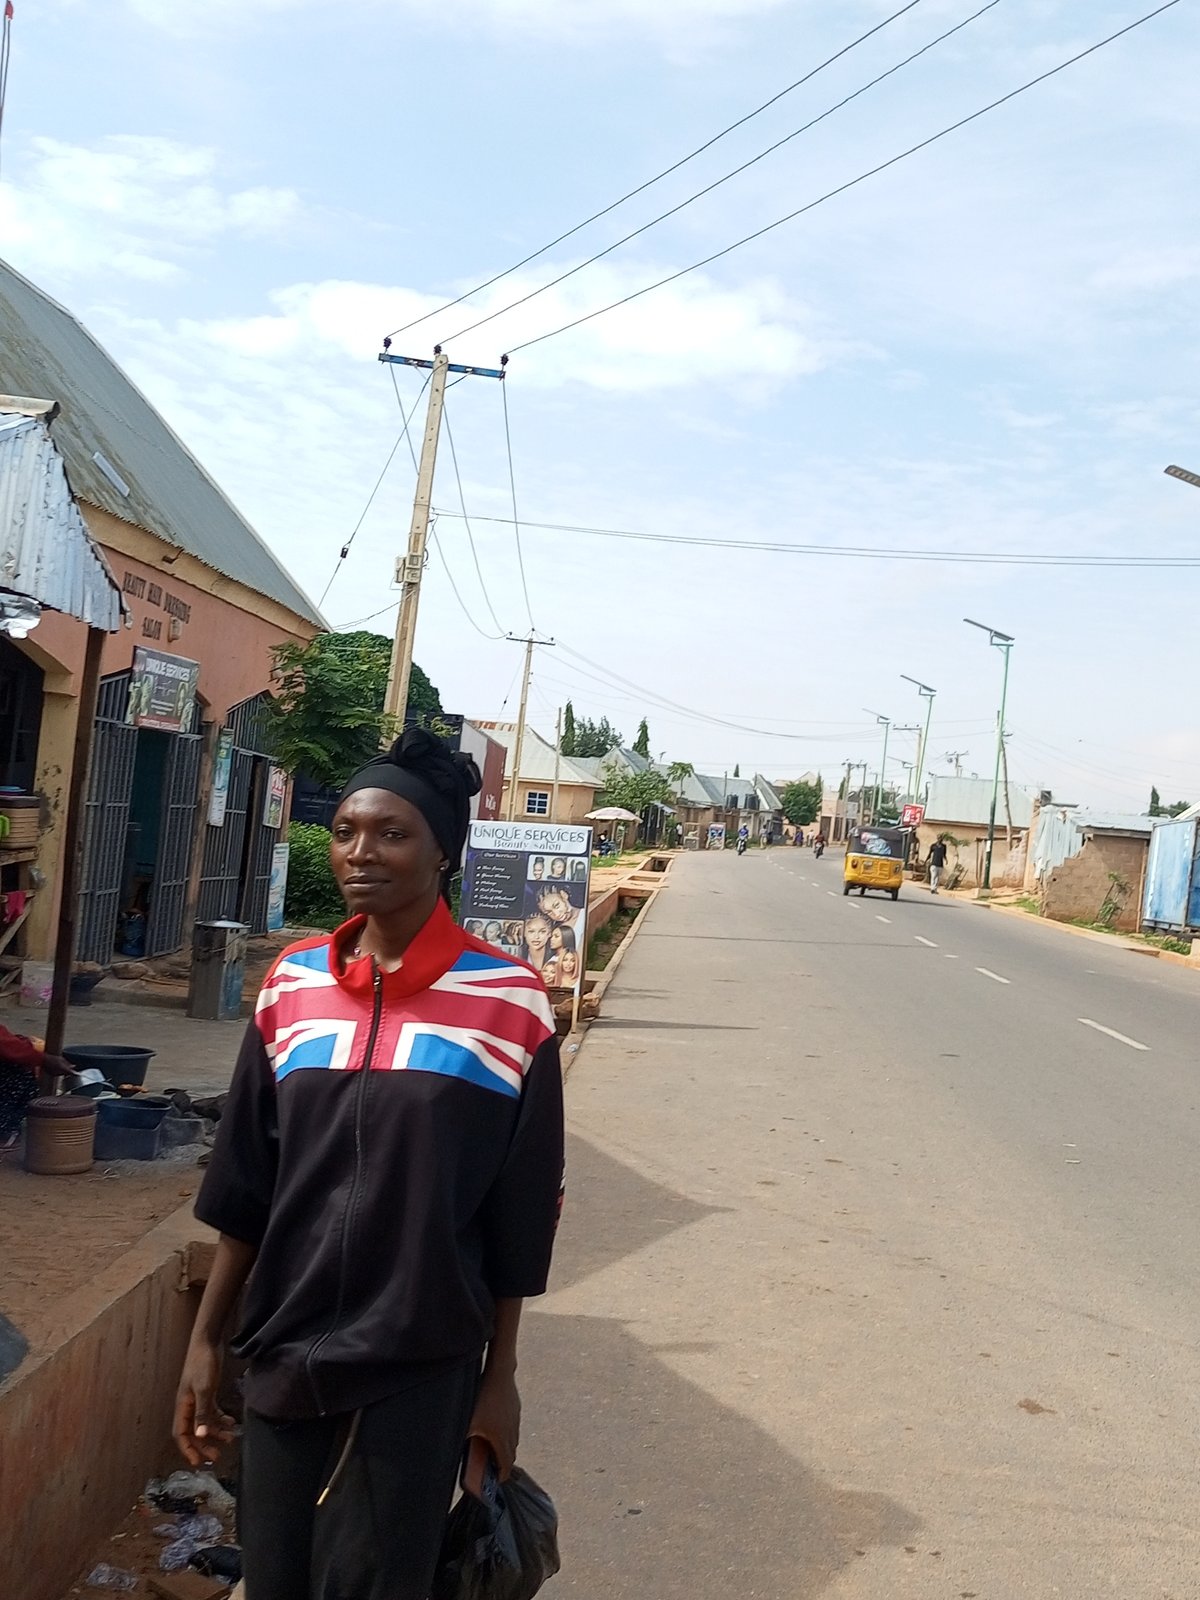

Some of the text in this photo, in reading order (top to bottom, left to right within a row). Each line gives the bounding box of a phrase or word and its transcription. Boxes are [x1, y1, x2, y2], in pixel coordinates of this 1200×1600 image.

[474, 826, 585, 843] UNIQUE SERVICES
[494, 840, 529, 849] Beauty
